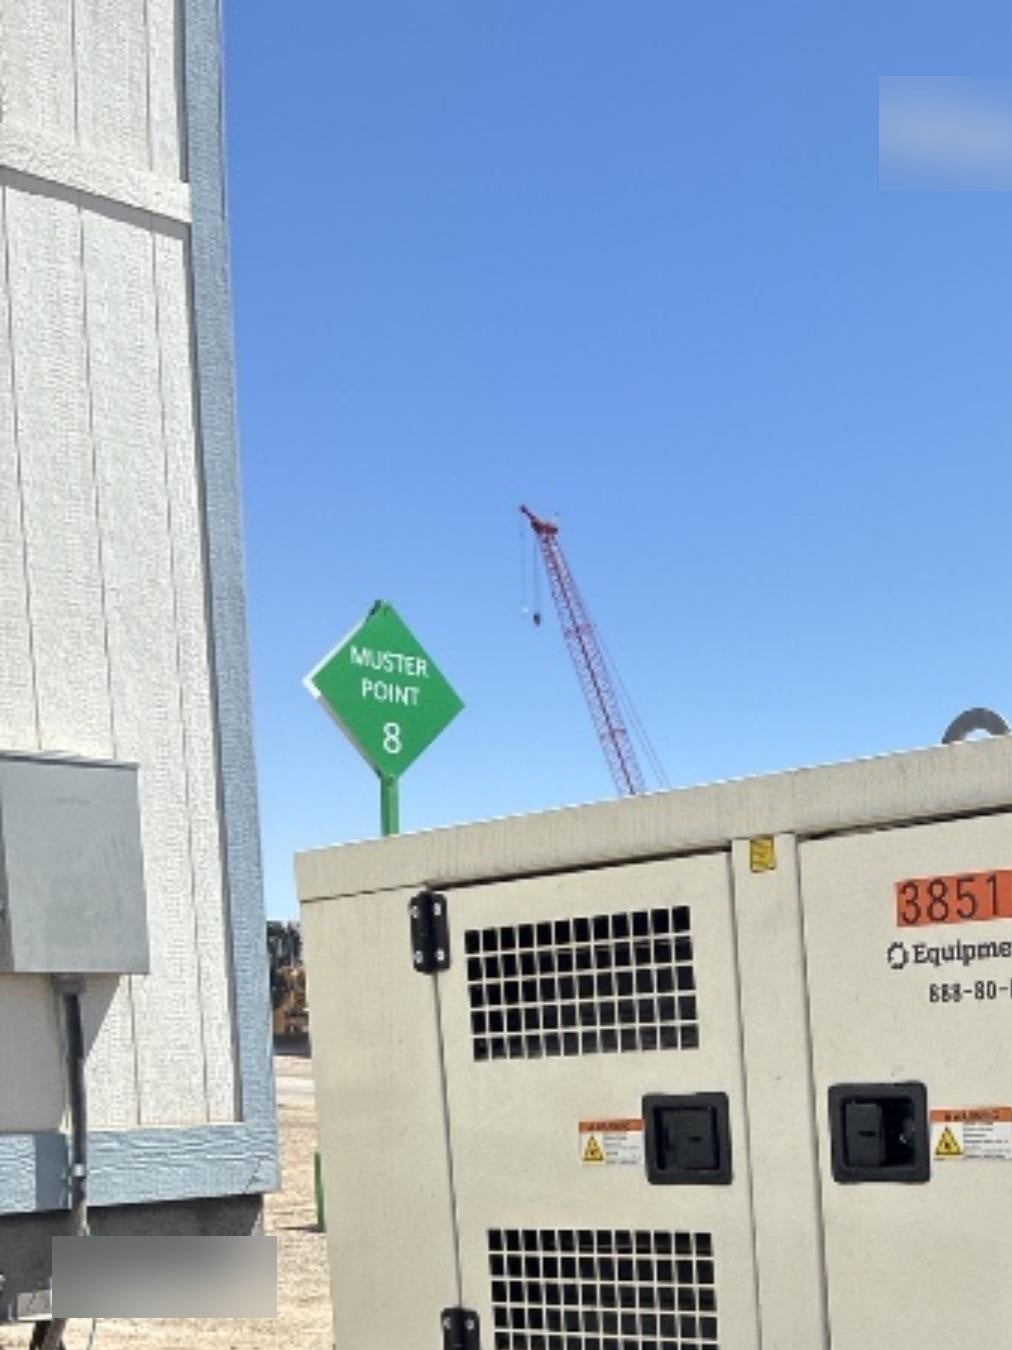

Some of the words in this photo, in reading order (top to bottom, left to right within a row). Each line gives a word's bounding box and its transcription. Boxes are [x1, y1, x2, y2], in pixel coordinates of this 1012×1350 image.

[351, 645, 428, 679] MUSTER
[362, 677, 419, 706] POINT
[382, 721, 403, 754] 8
